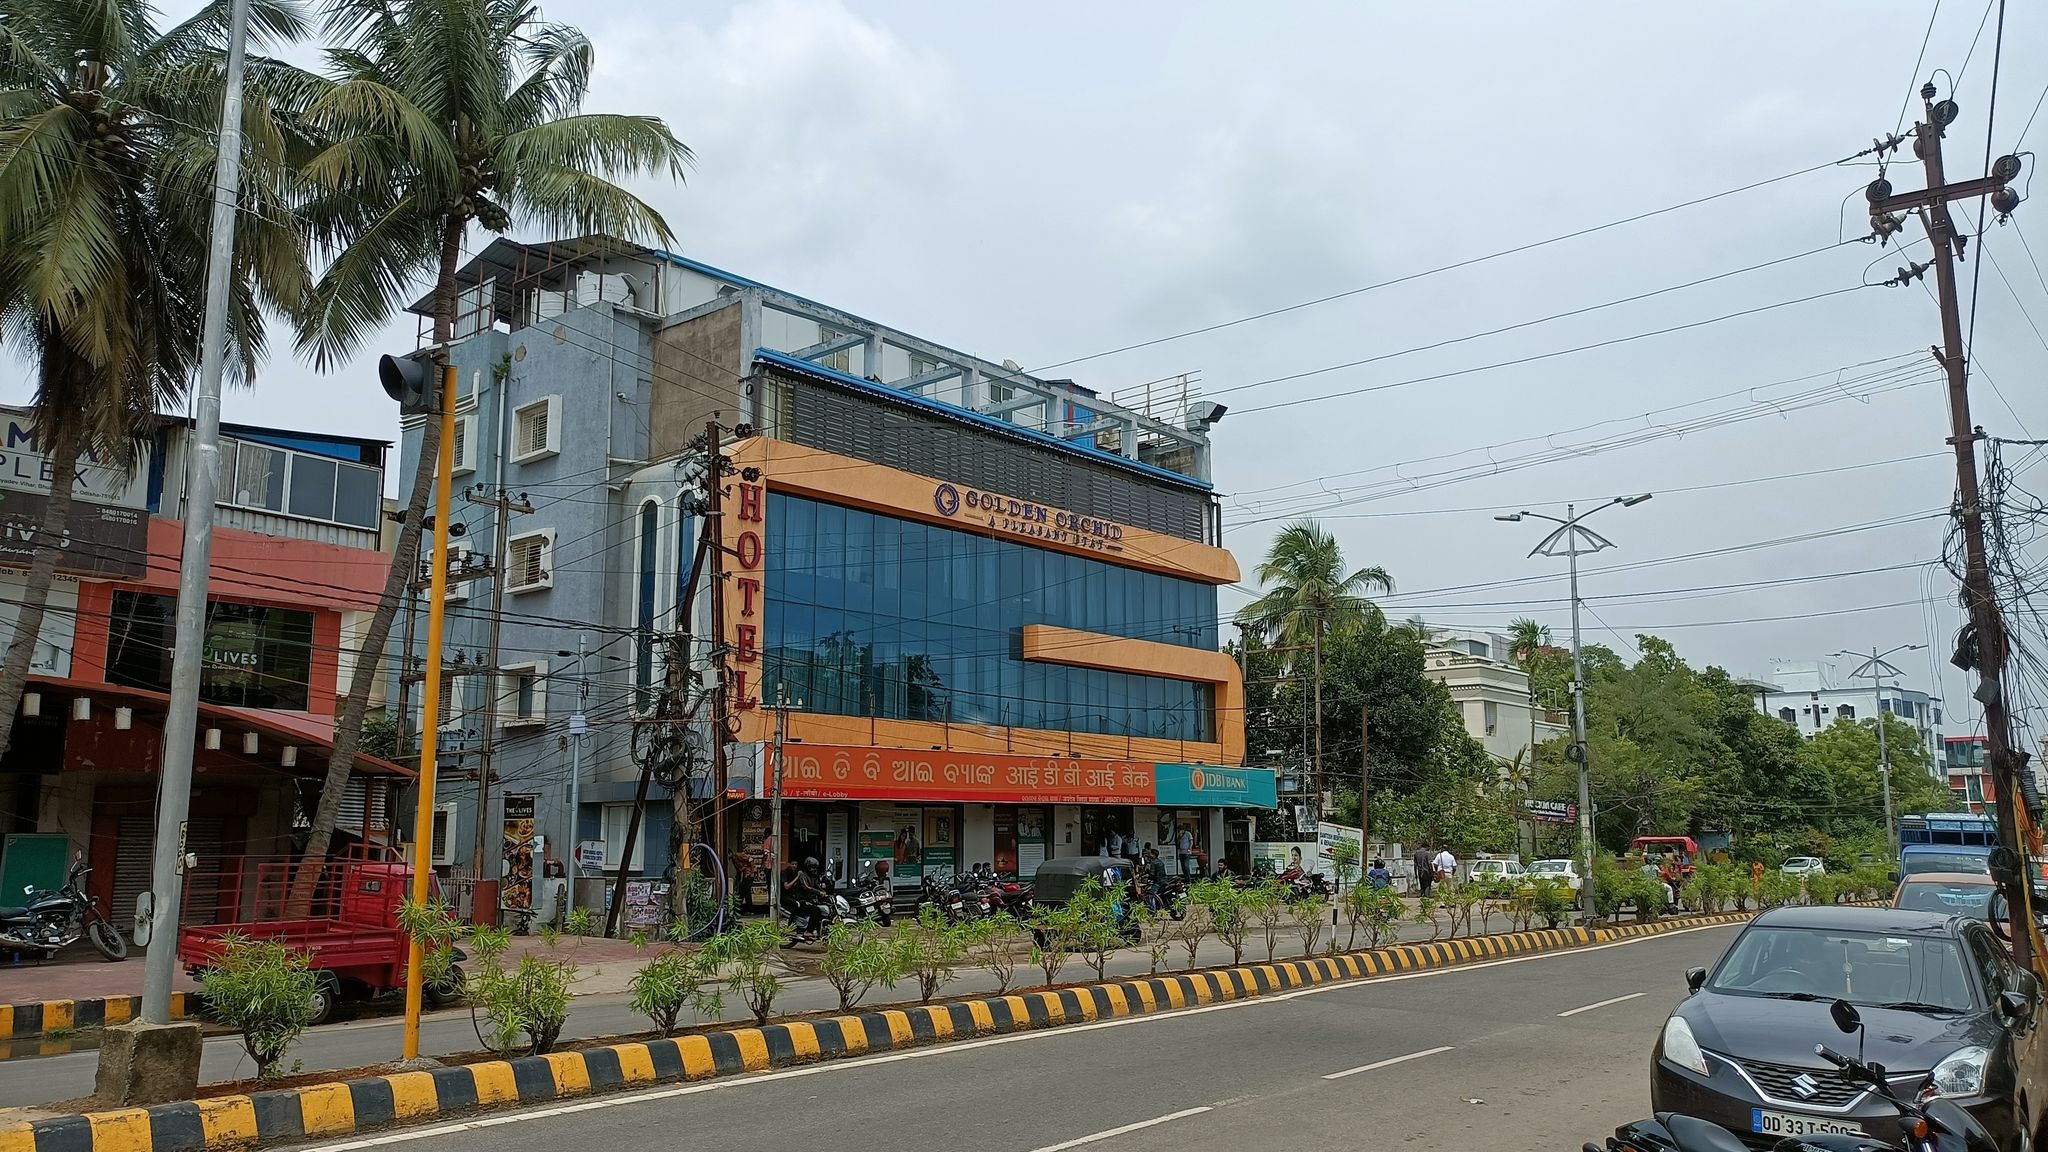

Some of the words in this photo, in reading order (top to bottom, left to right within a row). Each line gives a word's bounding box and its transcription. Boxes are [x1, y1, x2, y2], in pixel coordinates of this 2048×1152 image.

[965, 490, 1048, 523] GOLDEN
[1055, 511, 1123, 541] ORCHID
[988, 514, 996, 528] A
[1003, 518, 1068, 543] PLEASANT
[1073, 533, 1105, 551] STAY
[734, 482, 763, 710] HOTEL
[1005, 760, 1039, 787] आई
[1043, 760, 1060, 787] डी
[1064, 761, 1081, 789] बी
[1085, 763, 1115, 791] आई
[1121, 764, 1150, 789] बैंक
[1205, 773, 1225, 789] IDBI
[1226, 776, 1246, 789] BANK
[823, 790, 849, 798] e-Lobby
[1762, 1115, 1780, 1132] OD
[1785, 1119, 1804, 1135] 33
